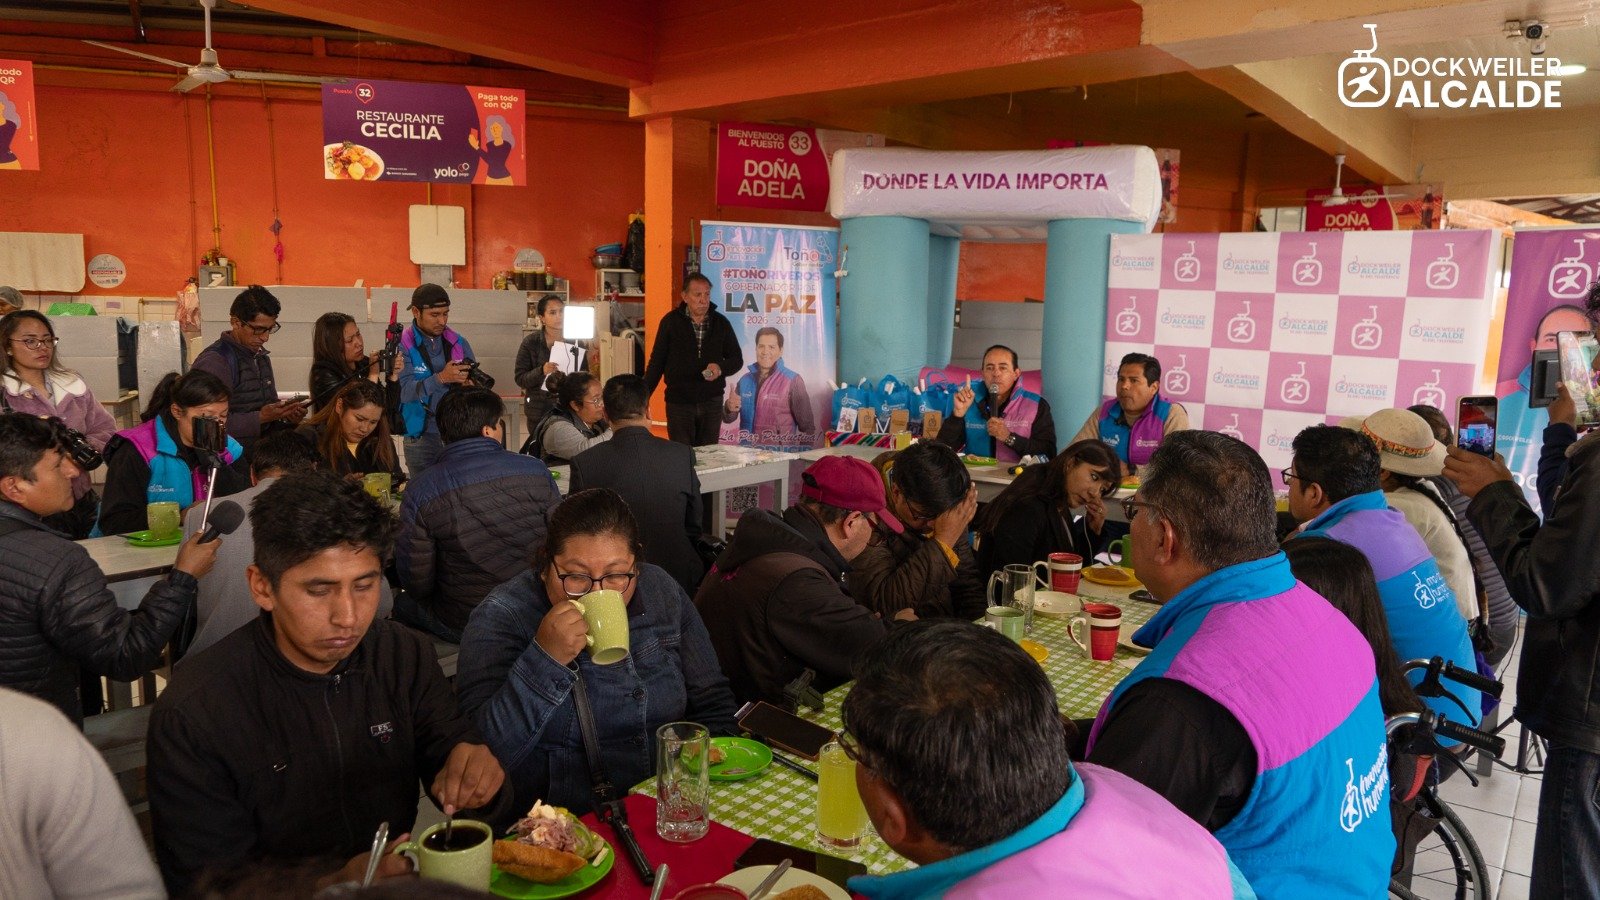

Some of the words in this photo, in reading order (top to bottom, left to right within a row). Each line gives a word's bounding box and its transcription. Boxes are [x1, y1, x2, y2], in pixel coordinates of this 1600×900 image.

[0, 76, 15, 85] QR
[359, 88, 371, 98] 32
[477, 93, 498, 103] Paga
[500, 94, 519, 103] todo
[483, 101, 498, 109] con
[500, 101, 513, 110] QR
[356, 110, 445, 125] RESTAURANTE
[360, 121, 442, 141] CECILIA
[728, 129, 785, 141] BIENVENIDOS
[738, 138, 749, 147] AL
[751, 139, 784, 149] PUESTO
[790, 135, 809, 150] 33
[433, 166, 458, 179] yolo
[744, 157, 802, 180] DOÑA
[863, 173, 928, 190] DONDE
[934, 173, 959, 190] LA
[961, 173, 1010, 190] VIDA
[1016, 173, 1108, 191] IMPORTA
[737, 179, 805, 200] ADELA
[1325, 210, 1370, 227] DOÑA
[725, 293, 759, 313] LA
[765, 293, 817, 314] PAZ
[747, 315, 768, 325] 2026
[1423, 331, 1465, 339] ALCALDE
[1348, 388, 1387, 396] ALCALDE
[718, 430, 735, 442] La
[739, 430, 759, 444] Paz
